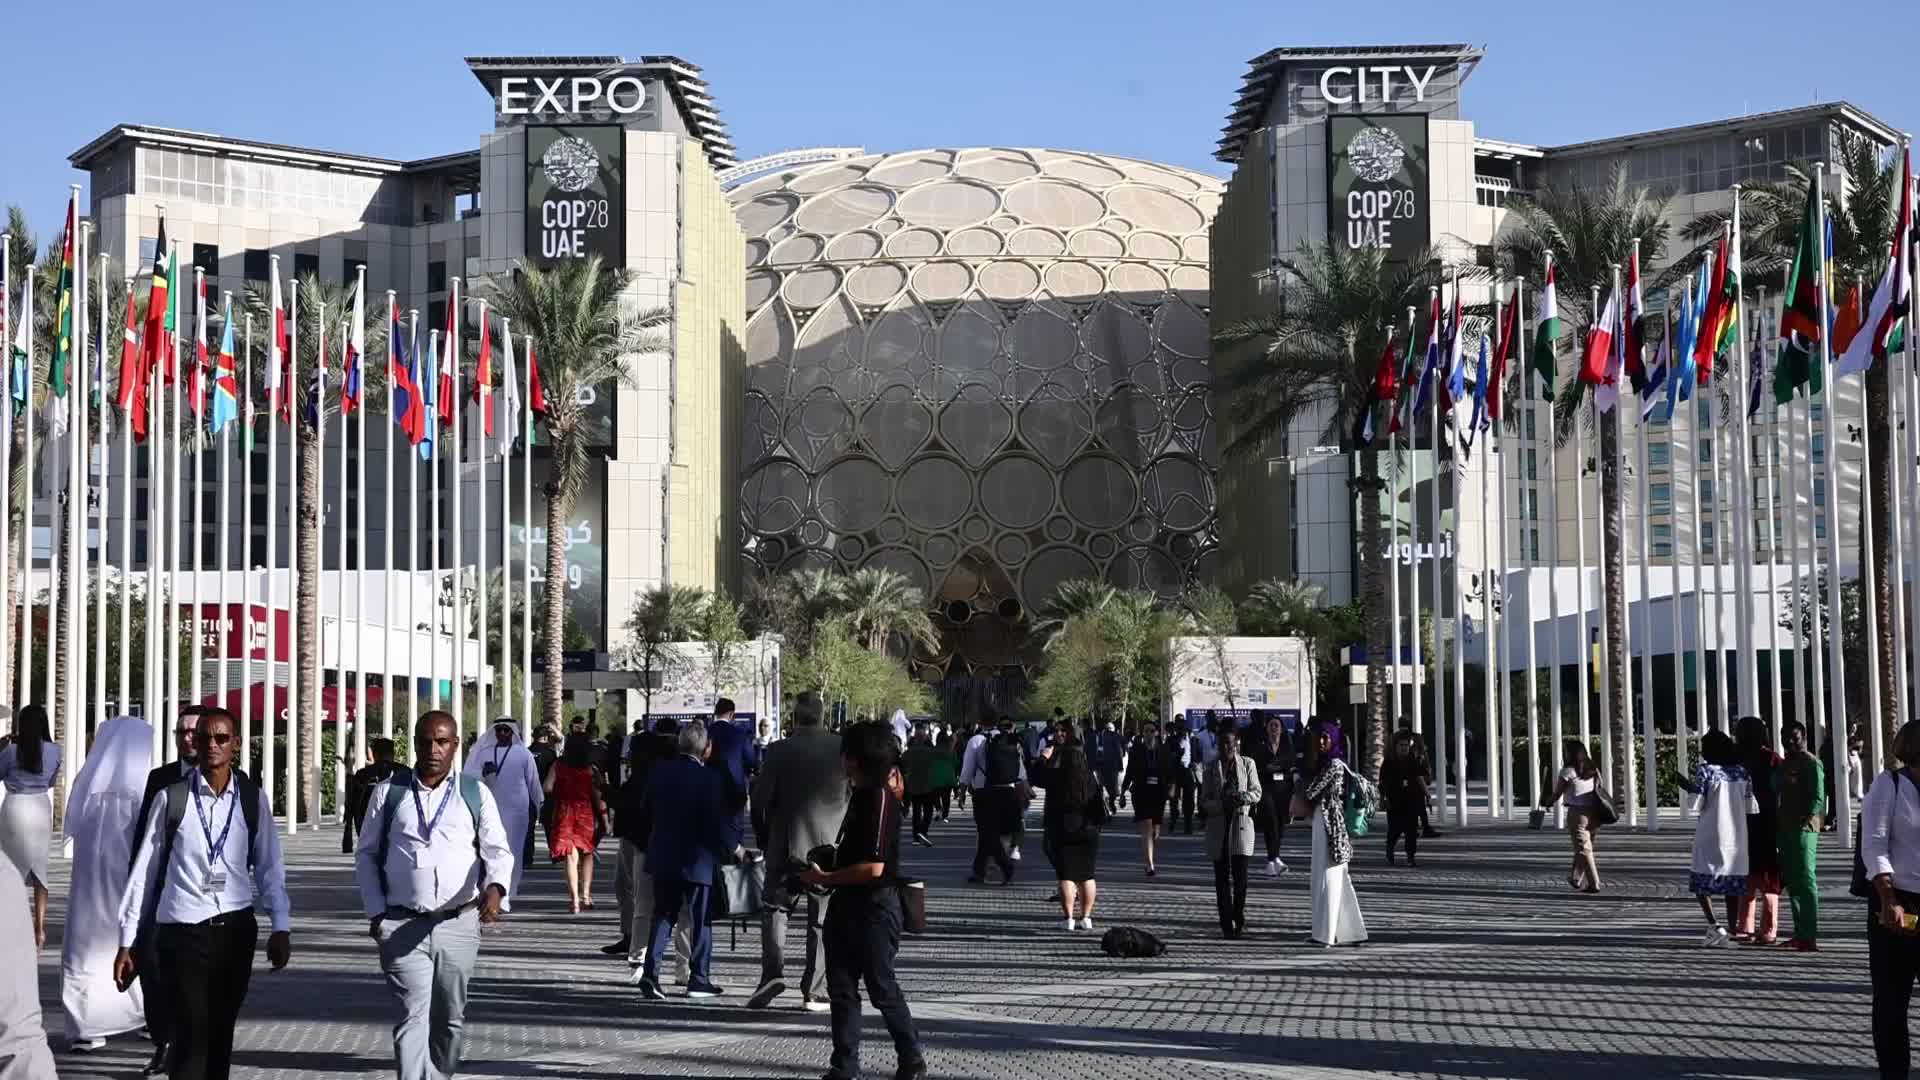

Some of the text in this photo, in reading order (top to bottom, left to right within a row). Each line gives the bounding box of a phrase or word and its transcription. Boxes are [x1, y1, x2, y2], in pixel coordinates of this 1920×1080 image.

[501, 76, 646, 114] EXPO
[1320, 65, 1437, 104] CITY
[542, 199, 609, 228] COP28
[1347, 189, 1415, 219] COP28
[542, 229, 585, 258] UAE
[1347, 220, 1392, 249] UAE
